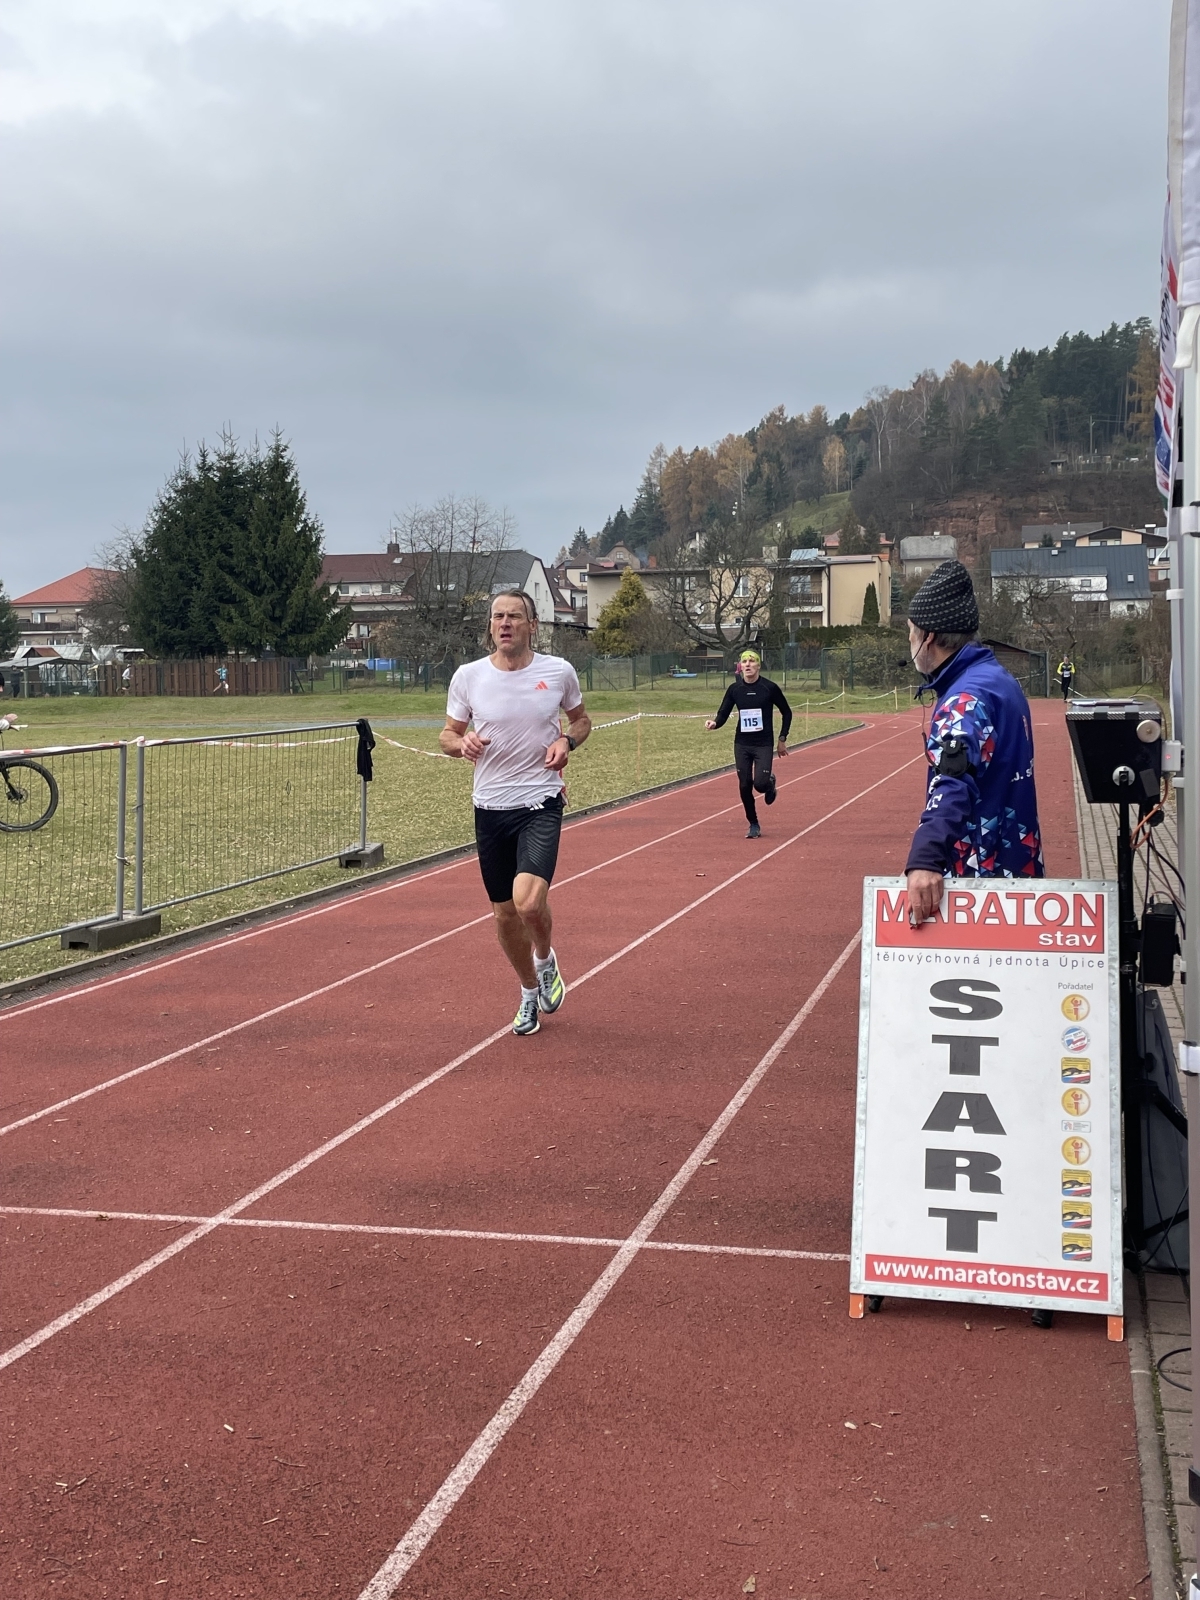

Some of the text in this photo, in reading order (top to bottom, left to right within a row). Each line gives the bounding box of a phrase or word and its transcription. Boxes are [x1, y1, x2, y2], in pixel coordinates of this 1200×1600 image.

[743, 717, 759, 728] 115
[1038, 930, 1097, 947] stav
[876, 951, 1105, 969] tělovýchovná jednota Úpice
[1057, 982, 1094, 991] Pořadatel
[921, 978, 1007, 1254] START
[873, 1261, 1100, 1294] www.maratonstav.cz
